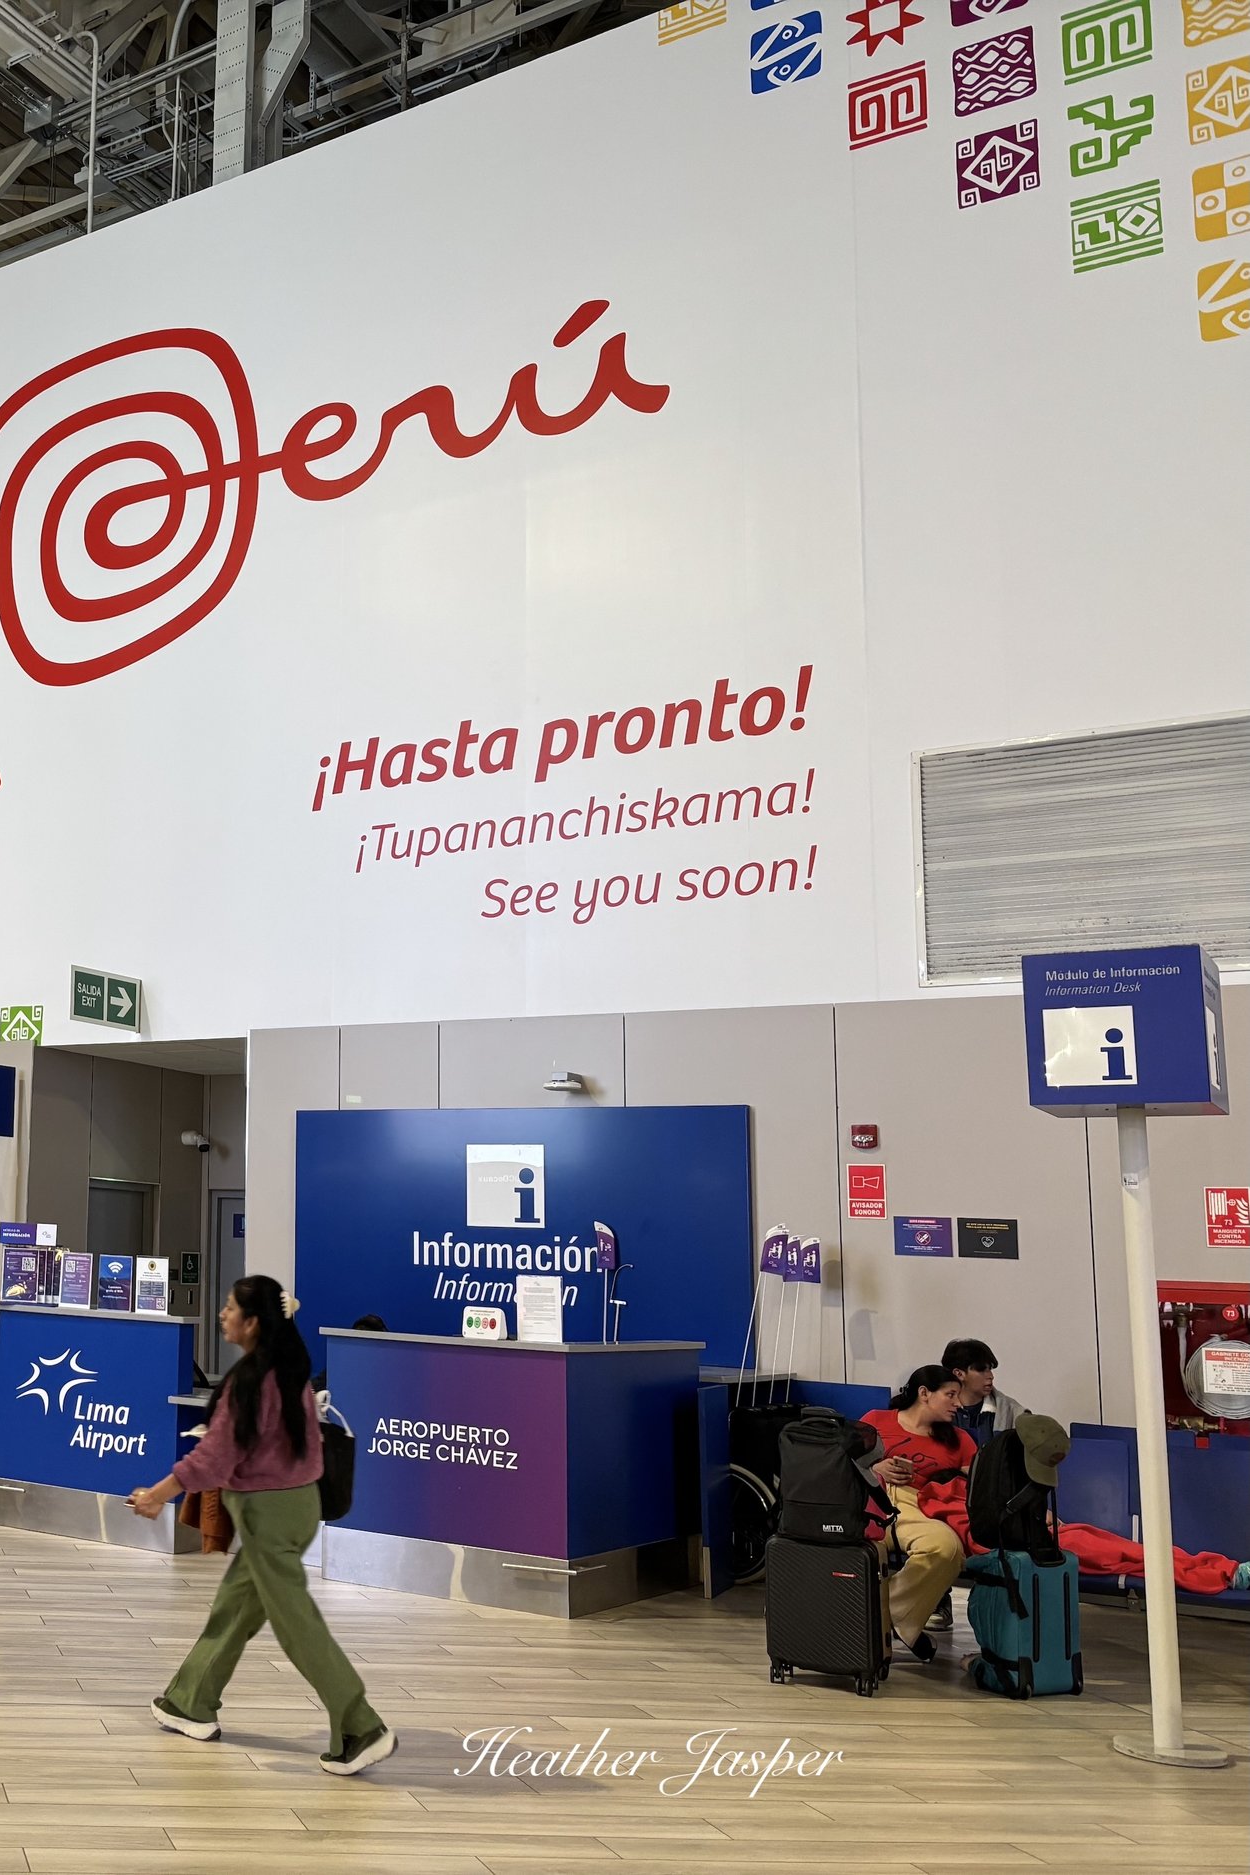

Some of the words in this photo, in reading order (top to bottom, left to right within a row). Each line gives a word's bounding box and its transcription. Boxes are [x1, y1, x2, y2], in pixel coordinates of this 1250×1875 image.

[311, 720, 519, 811] ¡Hasta
[535, 664, 814, 782] pronto!
[355, 767, 816, 873] ¡Tupananchiskama!
[481, 878, 558, 918] See
[573, 872, 661, 924] you
[677, 845, 817, 901] soon!
[77, 982, 102, 997] SALIDA
[1045, 970, 1089, 981] Módulo
[1092, 968, 1106, 979] de
[1110, 965, 1180, 978] Información
[1045, 983, 1110, 997] Information
[1113, 981, 1141, 993] Desk
[81, 995, 97, 1008] EXIT
[412, 1231, 603, 1272] Información
[433, 1272, 579, 1307] Informn
[73, 1395, 130, 1425] Lima
[70, 1424, 147, 1458] Airport
[375, 1418, 510, 1447] AEROPUERTO
[367, 1437, 431, 1460] JORGE
[435, 1443, 518, 1470] CHÁVEZ
